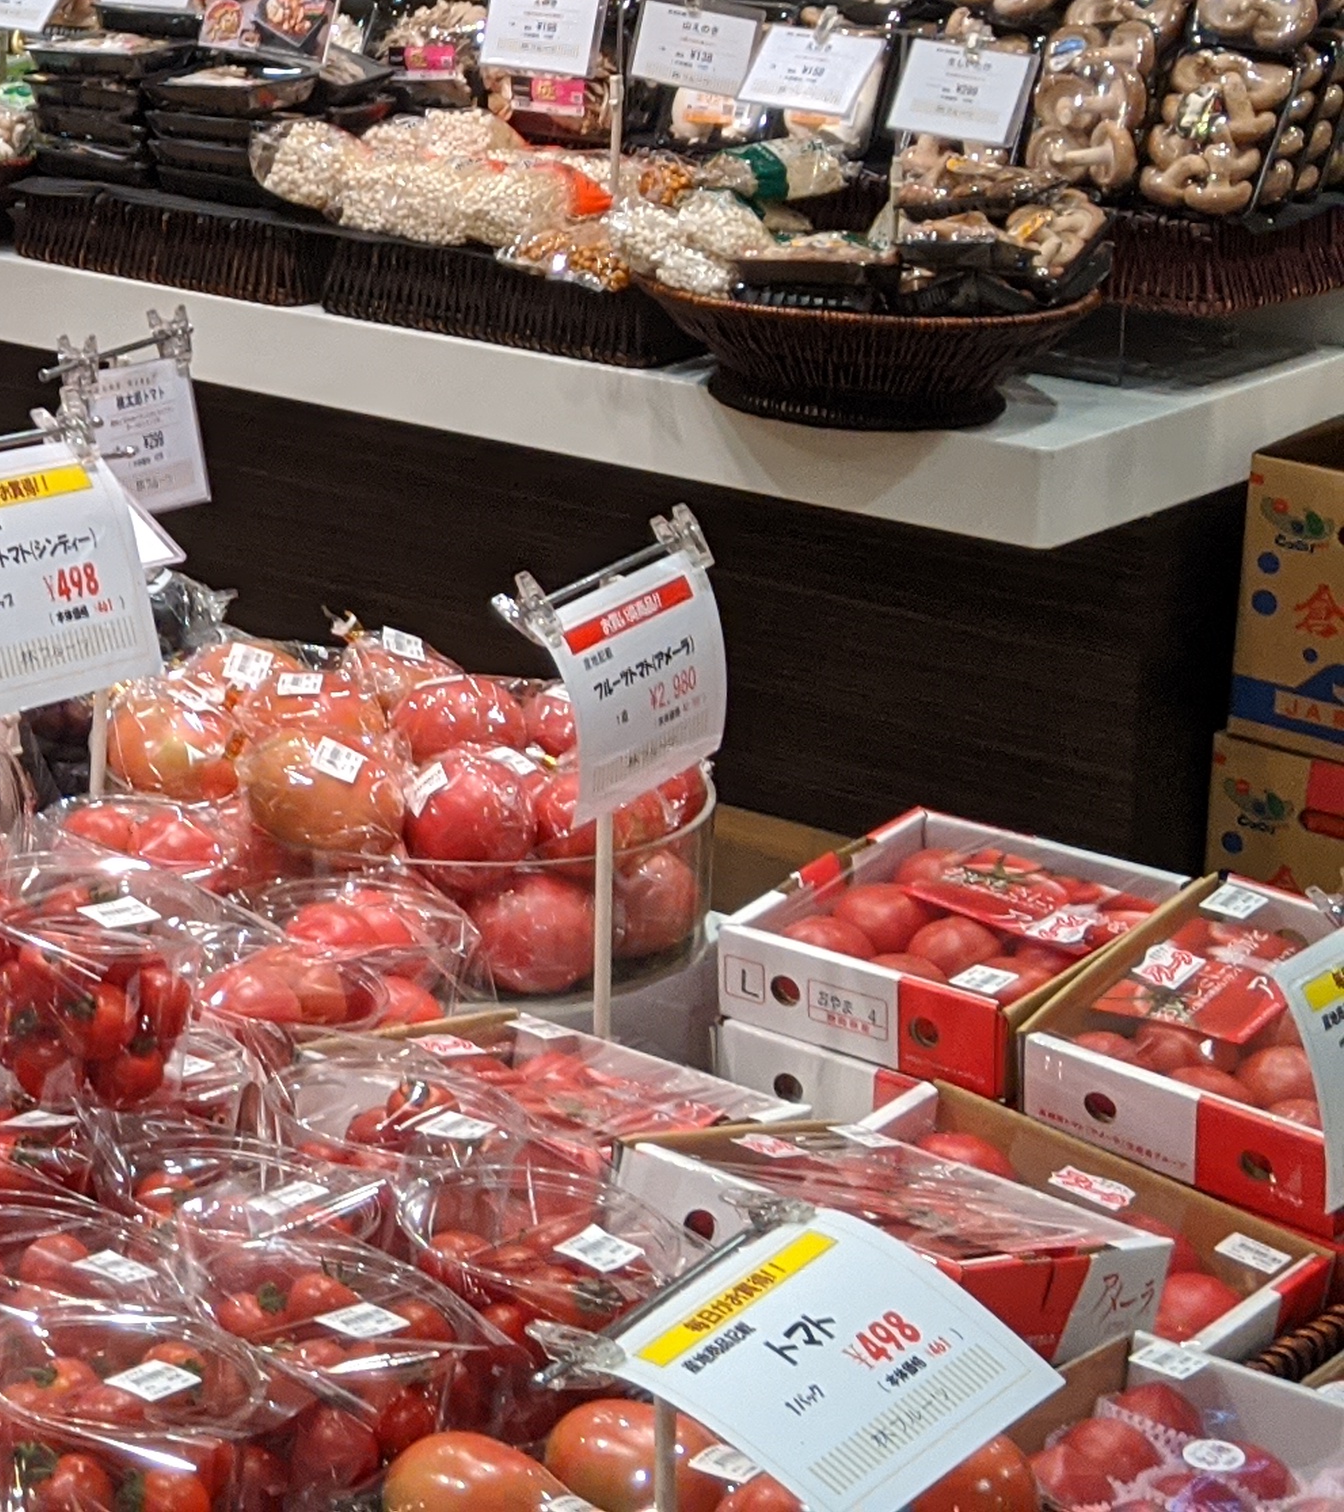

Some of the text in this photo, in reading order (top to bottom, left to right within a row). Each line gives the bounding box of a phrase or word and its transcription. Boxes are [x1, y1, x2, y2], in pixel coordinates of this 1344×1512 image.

[116, 387, 165, 411] 桃太郎トマト
[43, 561, 100, 603] ¥498
[739, 968, 760, 1000] L
[1092, 1271, 1156, 1321] アメーラ
[763, 1311, 837, 1367] トマト
[784, 1309, 923, 1418] 1パック ¥498
